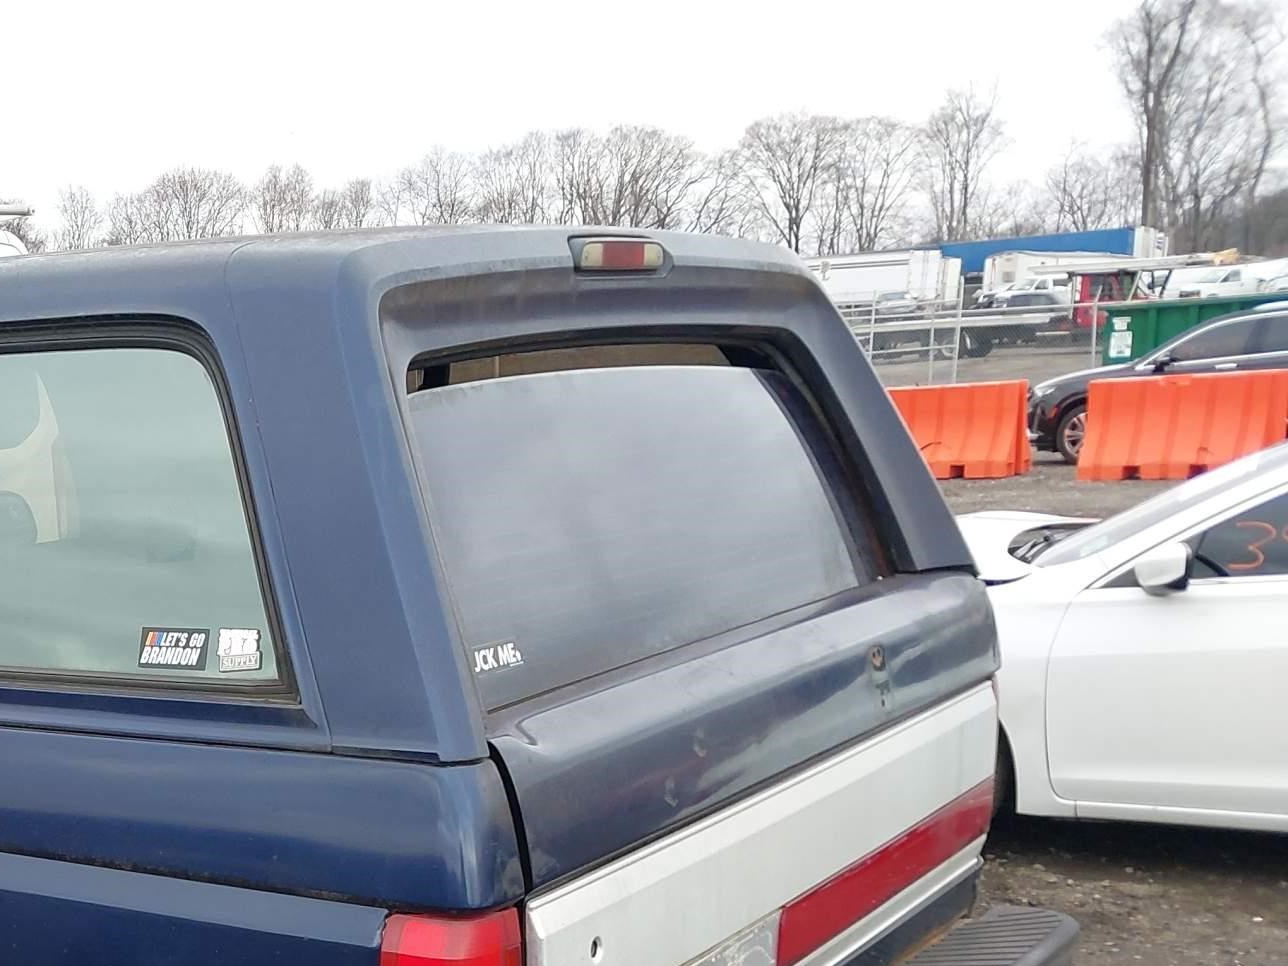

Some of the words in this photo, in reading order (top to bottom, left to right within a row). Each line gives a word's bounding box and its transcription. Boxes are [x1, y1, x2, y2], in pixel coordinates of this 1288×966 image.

[160, 631, 188, 647] LET'S
[189, 632, 206, 648] GO
[139, 646, 201, 666] BRANDON
[222, 655, 257, 667] SUPPLY
